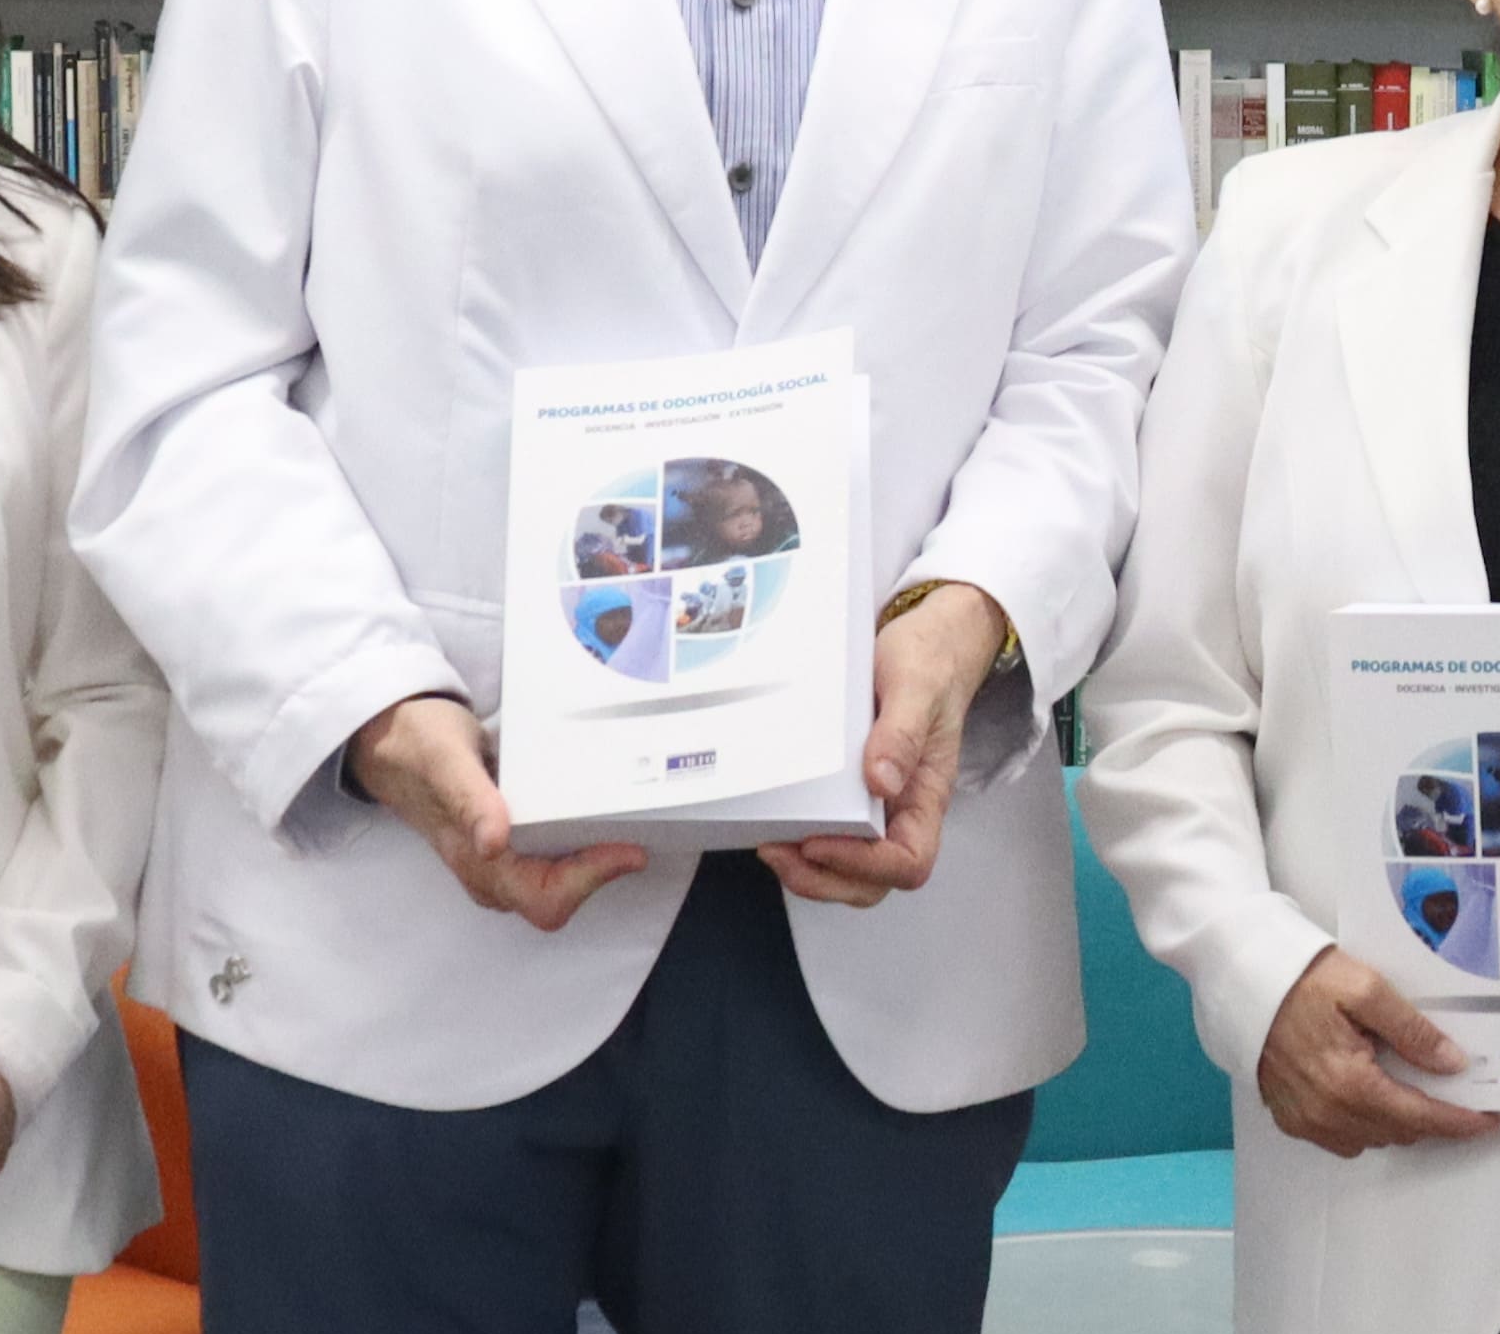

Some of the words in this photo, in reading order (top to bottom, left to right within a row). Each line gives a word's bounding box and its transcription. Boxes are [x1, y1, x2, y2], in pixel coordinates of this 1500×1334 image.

[538, 403, 635, 420] PROGRAMAS
[639, 401, 659, 413] DE
[663, 383, 774, 410] ODONTOLOGÍA
[777, 373, 829, 392] SOCIAL
[584, 422, 637, 434] DOCENCIA
[644, 412, 721, 429] INVESTIGACIÓN
[728, 402, 785, 419] EXTENSIÓN
[1351, 660, 1444, 674] PROGRAMAS
[1448, 660, 1468, 673] DE
[1396, 683, 1446, 694] DOCENCIA
